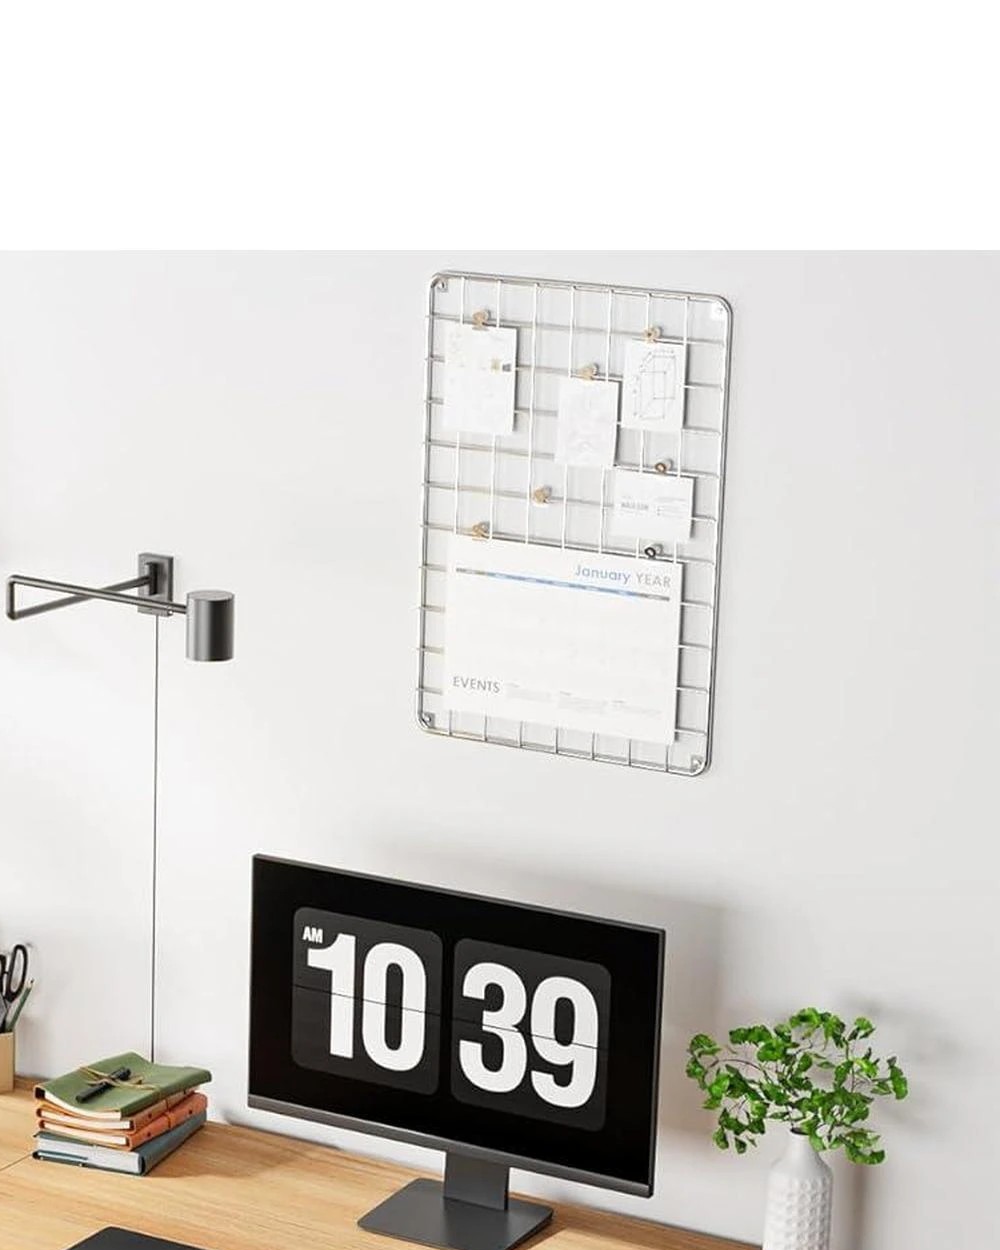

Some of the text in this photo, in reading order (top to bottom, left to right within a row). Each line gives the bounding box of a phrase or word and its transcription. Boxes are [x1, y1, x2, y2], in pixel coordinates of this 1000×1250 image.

[575, 564, 671, 588] January YEAR
[453, 676, 500, 693] EVENTS
[302, 926, 323, 943] AM
[307, 933, 598, 1108] 10 39
